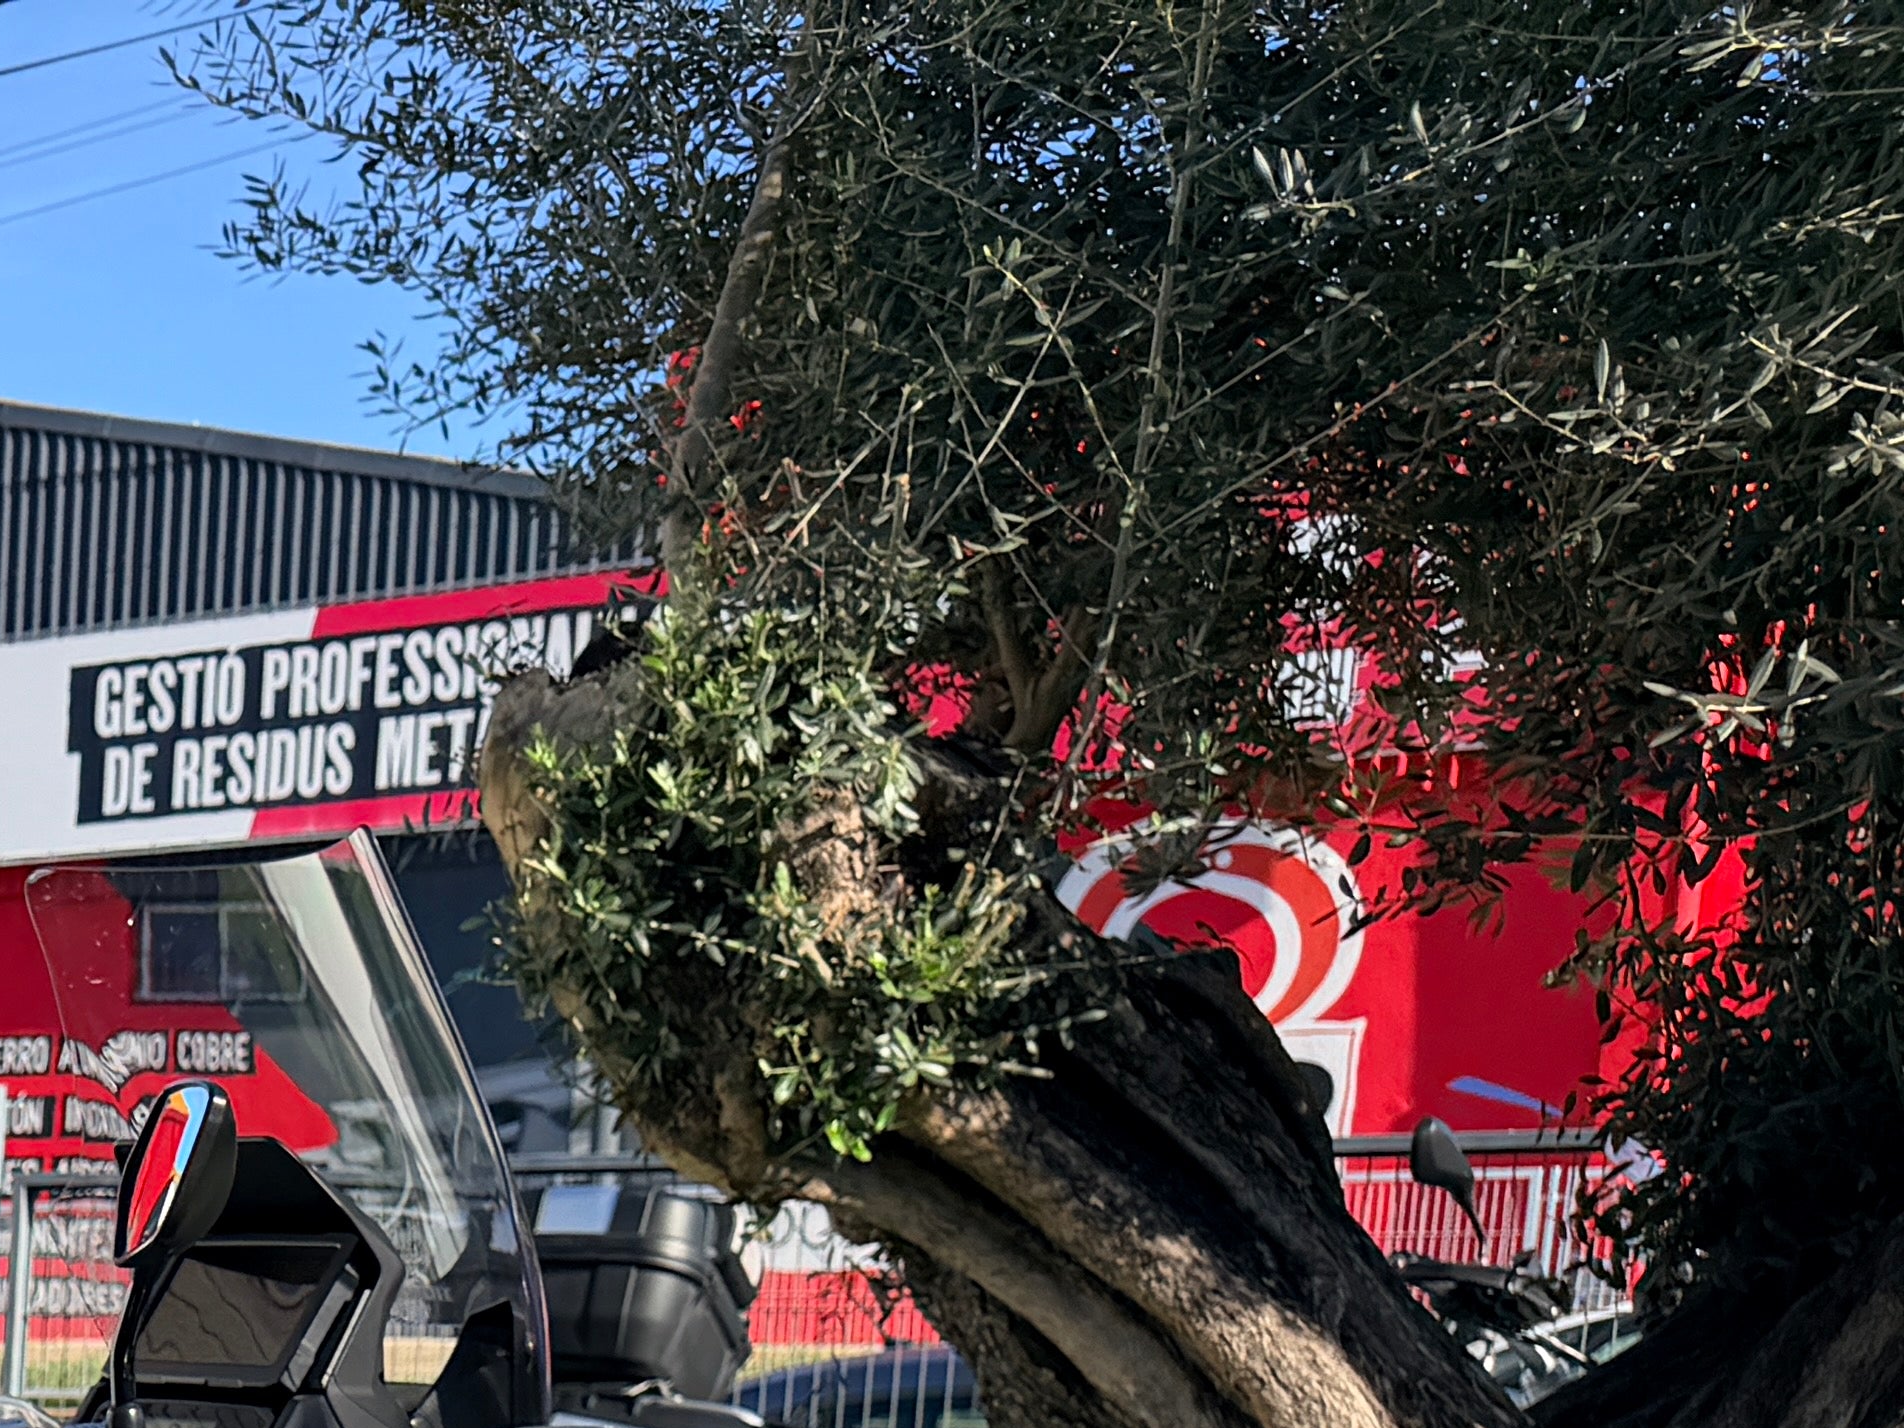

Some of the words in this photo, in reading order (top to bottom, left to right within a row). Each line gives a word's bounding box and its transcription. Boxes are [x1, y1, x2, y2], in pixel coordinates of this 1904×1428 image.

[94, 645, 246, 739] GESTIÓ
[101, 745, 158, 817] DE
[171, 721, 357, 810] RESIDUS
[175, 1030, 252, 1073] COBRE
